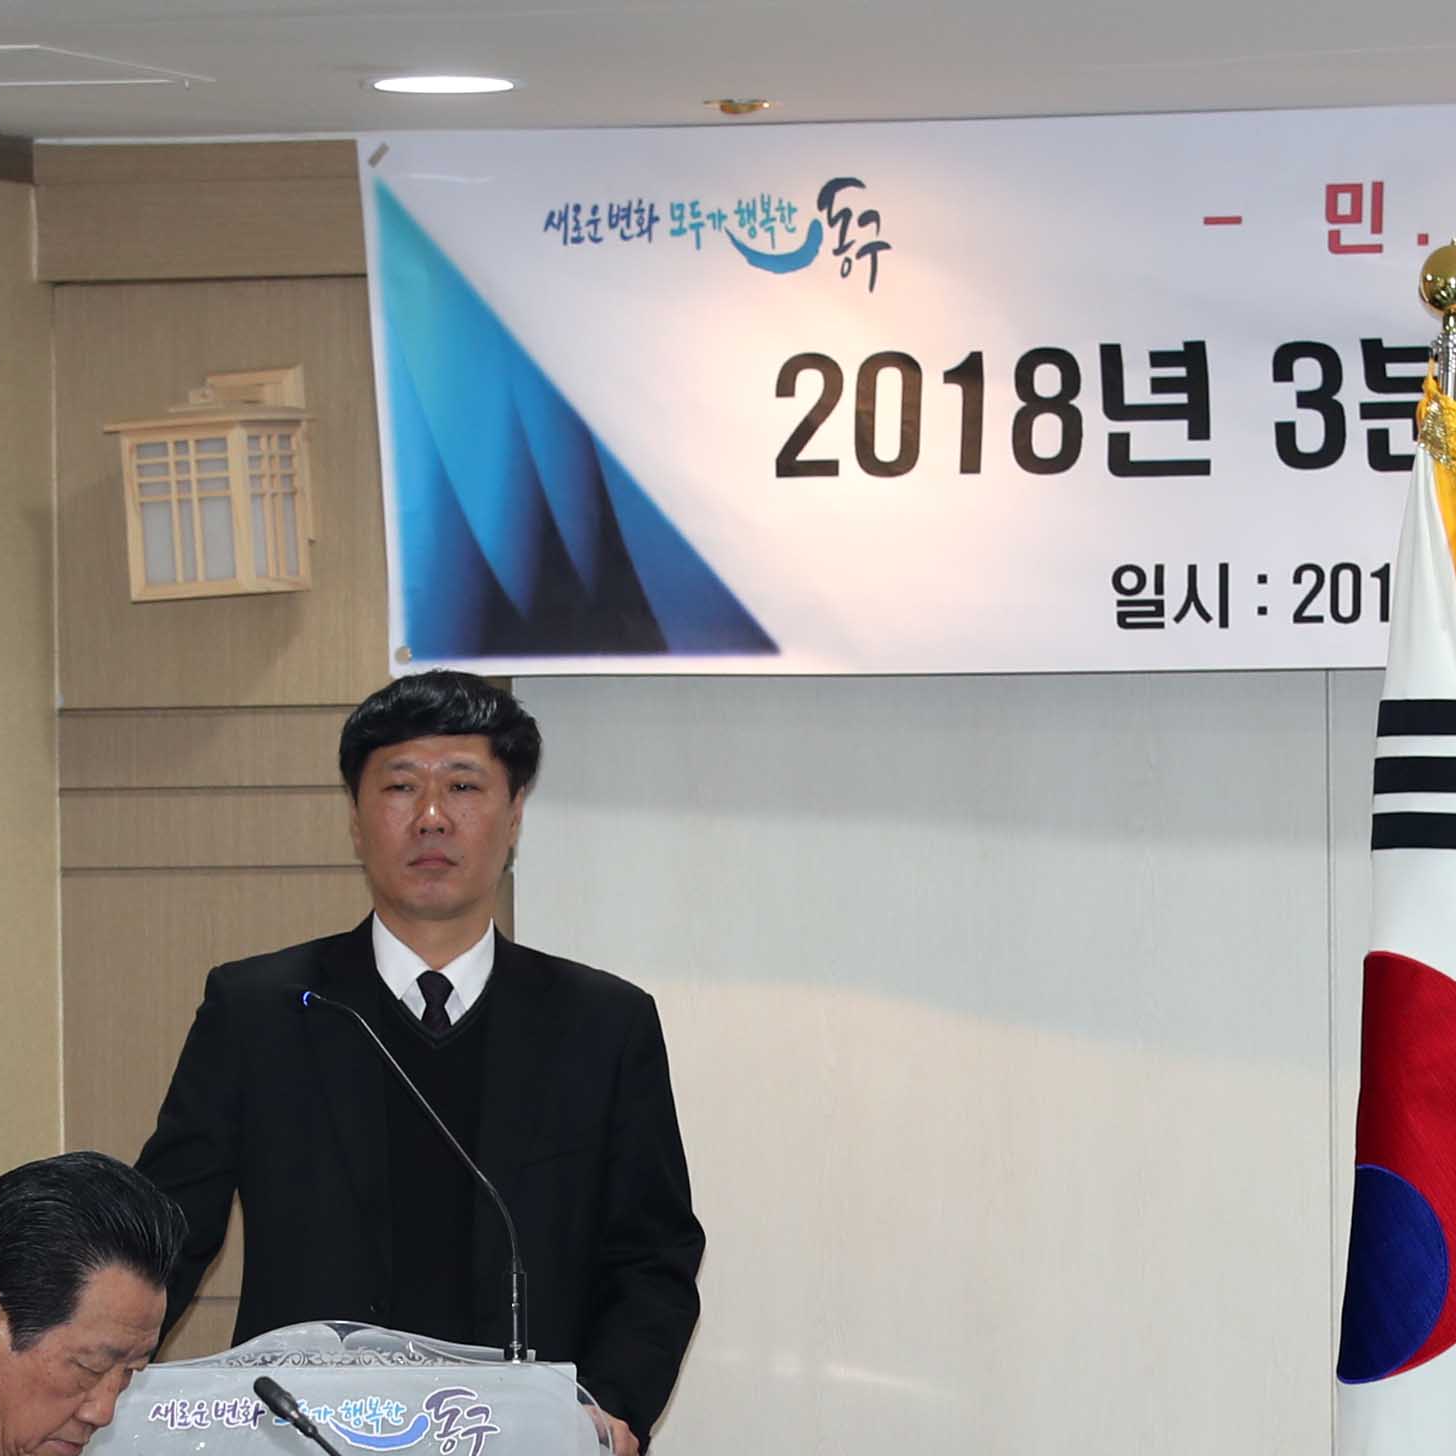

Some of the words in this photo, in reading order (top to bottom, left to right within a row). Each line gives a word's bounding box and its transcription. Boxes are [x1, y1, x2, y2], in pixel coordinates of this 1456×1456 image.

[669, 199, 728, 251] 모두가
[733, 193, 798, 250] 행복한
[816, 176, 893, 293] 동구
[775, 339, 1212, 479] 2018년
[1111, 561, 1230, 631] 일시
[339, 1396, 406, 1434] 행복한
